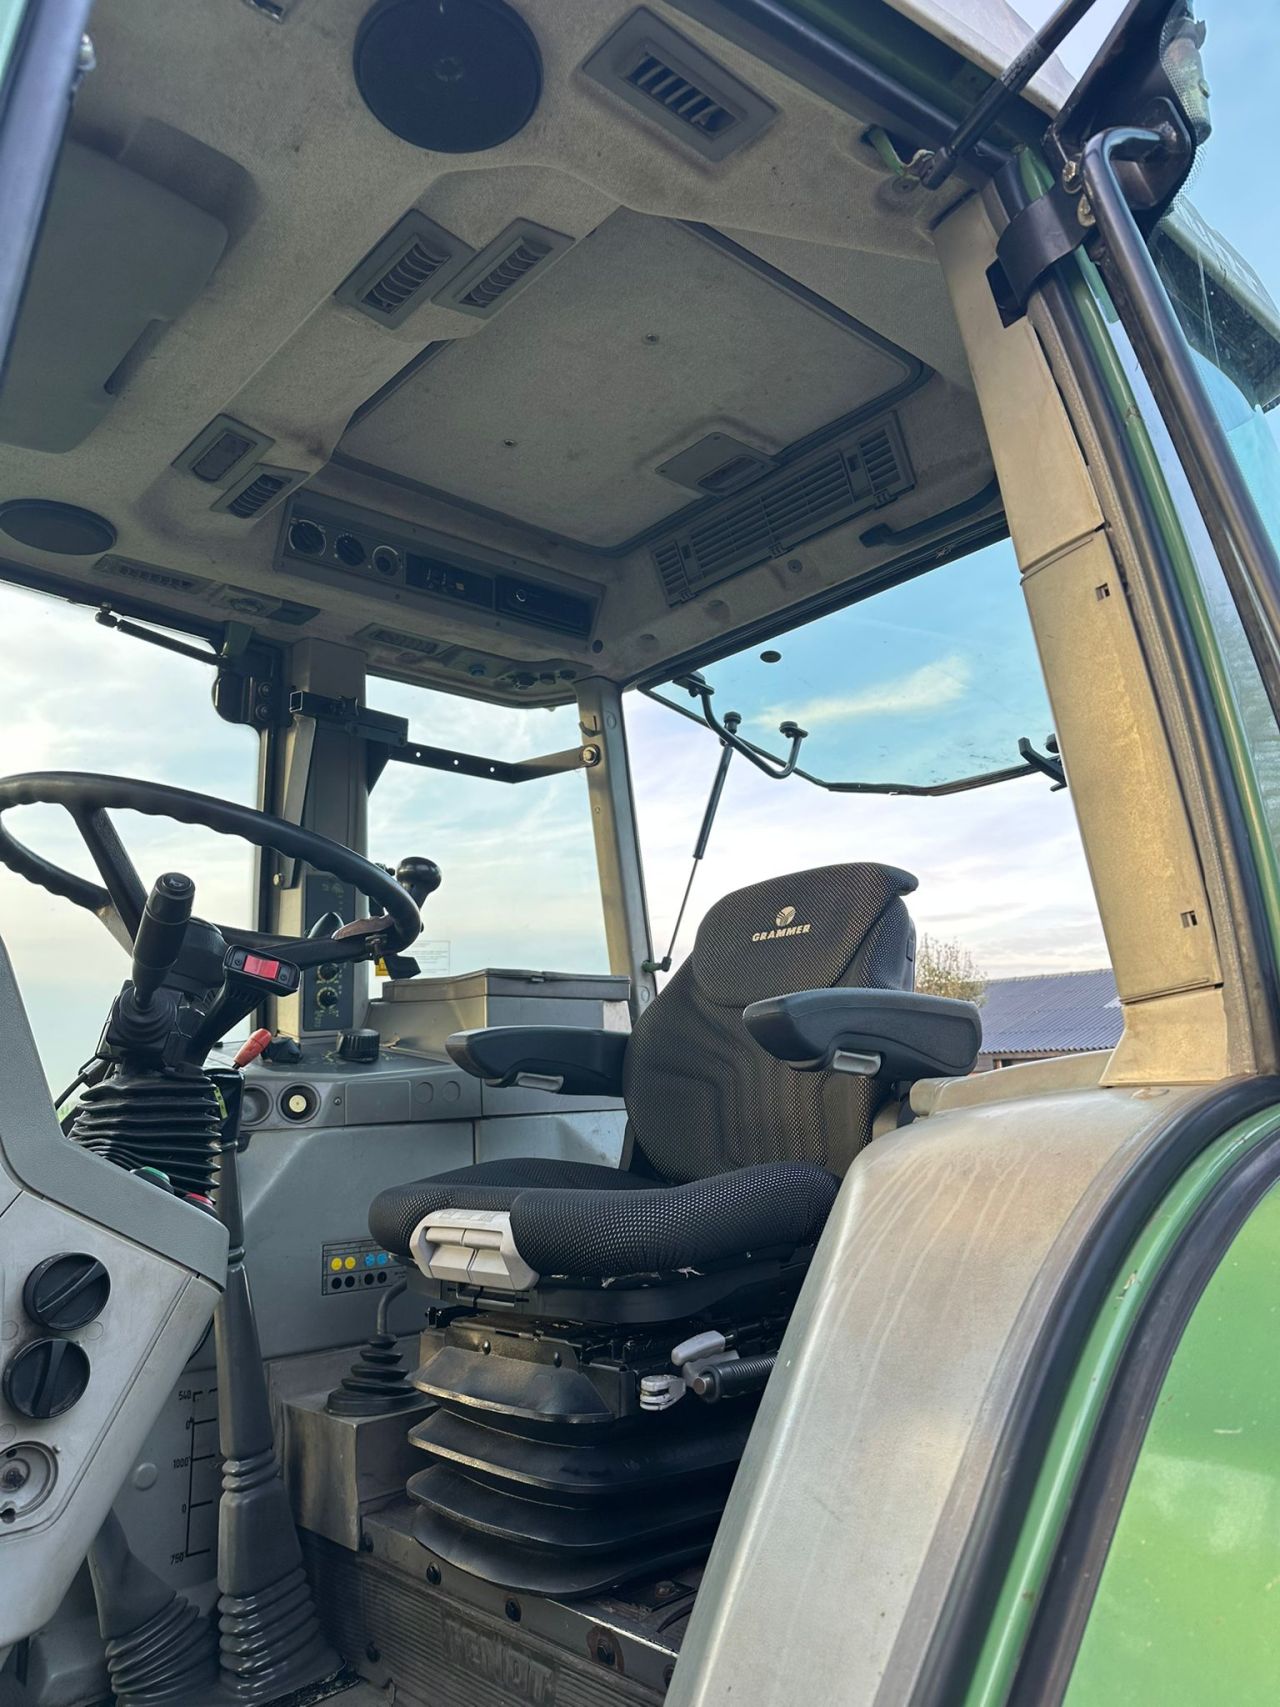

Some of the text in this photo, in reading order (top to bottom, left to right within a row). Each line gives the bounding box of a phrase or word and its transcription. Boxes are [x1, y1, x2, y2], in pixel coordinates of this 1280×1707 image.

[752, 924, 811, 942] GRAMMER
[178, 1390, 192, 1401] 540
[173, 1459, 189, 1469] 1000
[170, 1553, 184, 1565] 750
